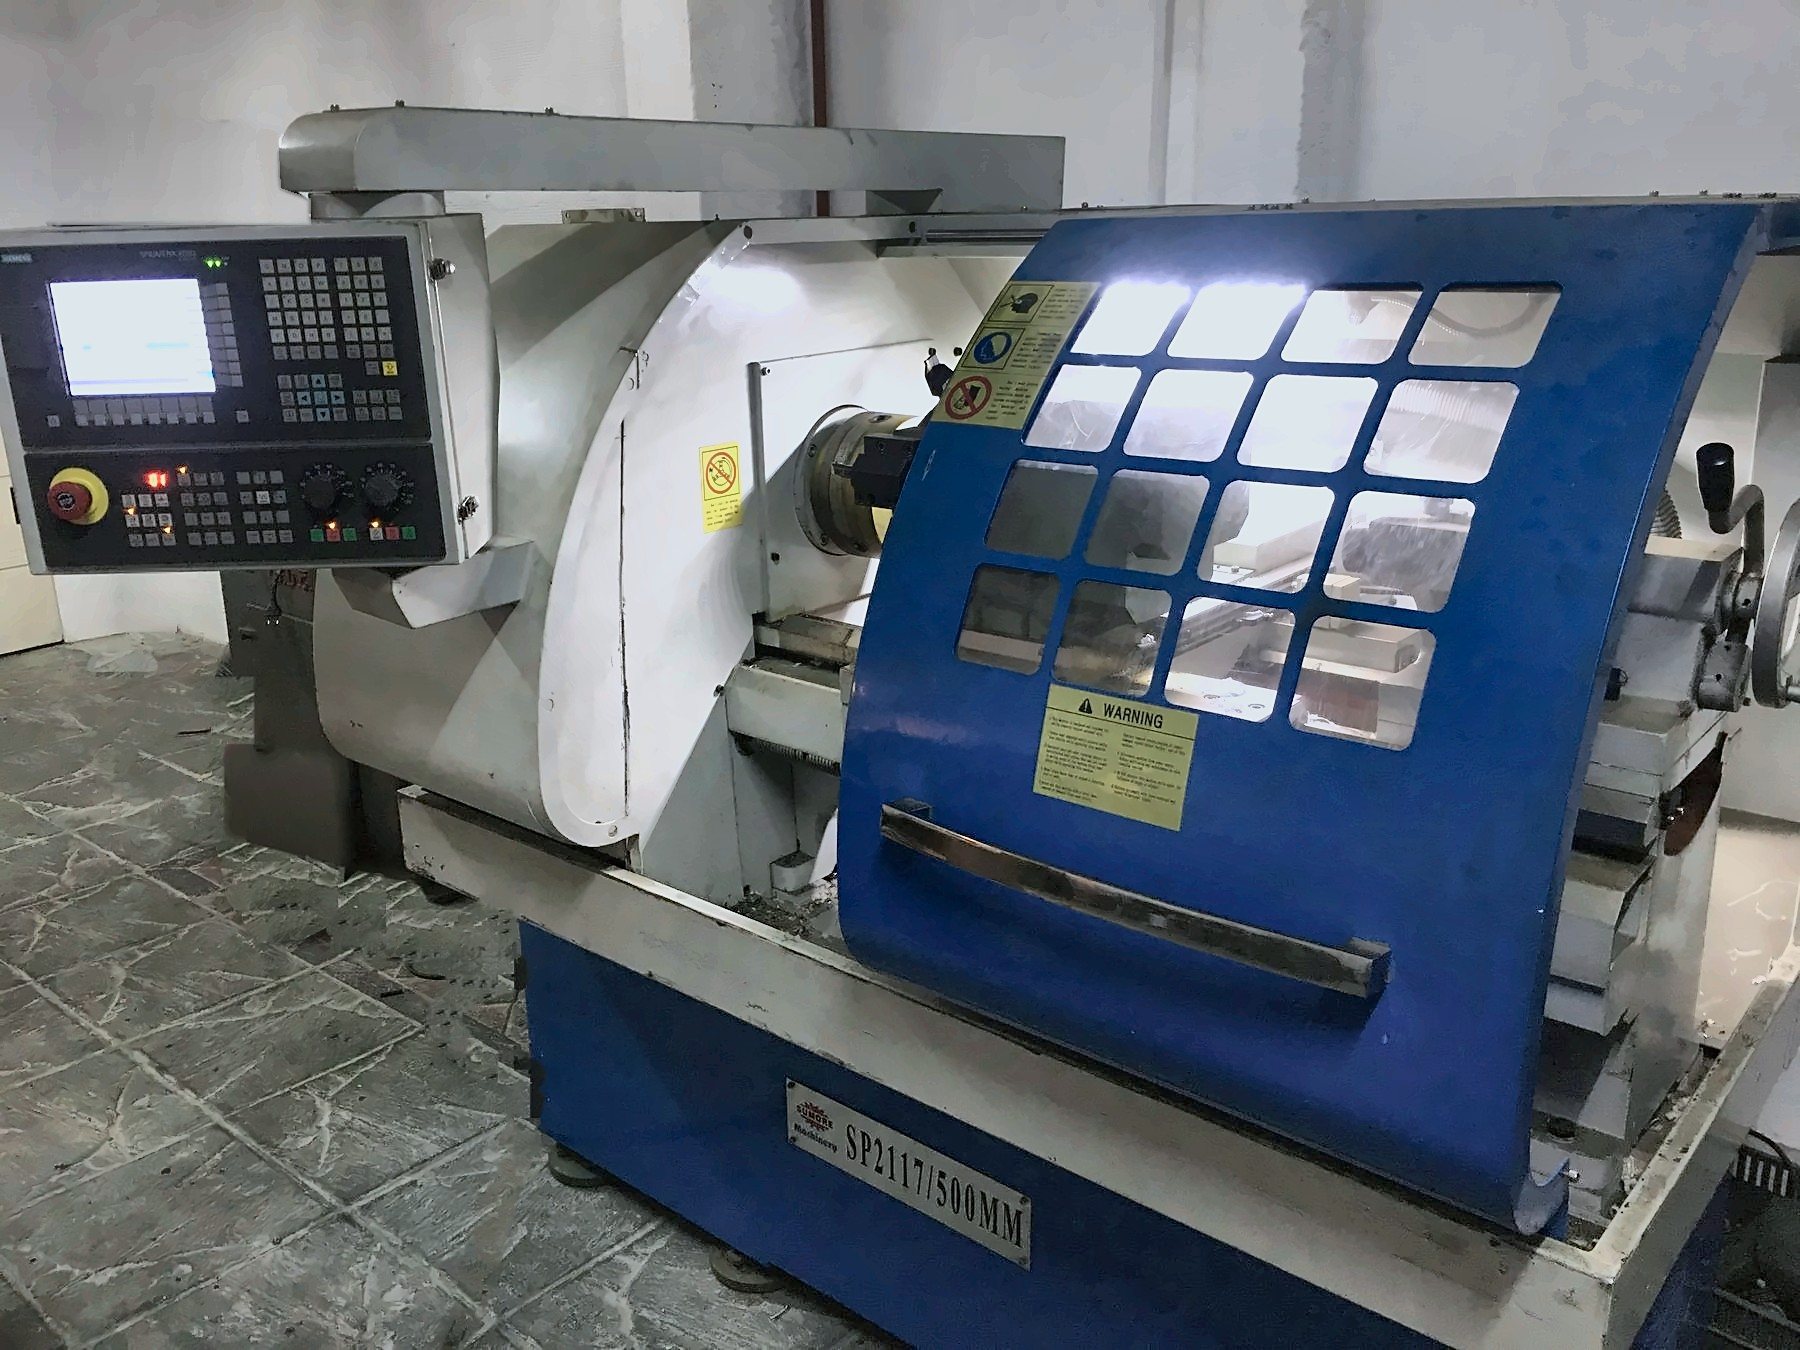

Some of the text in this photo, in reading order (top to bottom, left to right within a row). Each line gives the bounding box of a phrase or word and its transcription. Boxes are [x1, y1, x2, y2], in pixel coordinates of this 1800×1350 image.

[1103, 703, 1164, 729] WARNING
[796, 1104, 834, 1129] SUMORE
[794, 1123, 838, 1153] Machinery
[846, 1123, 1023, 1249] SP2117/500MM
